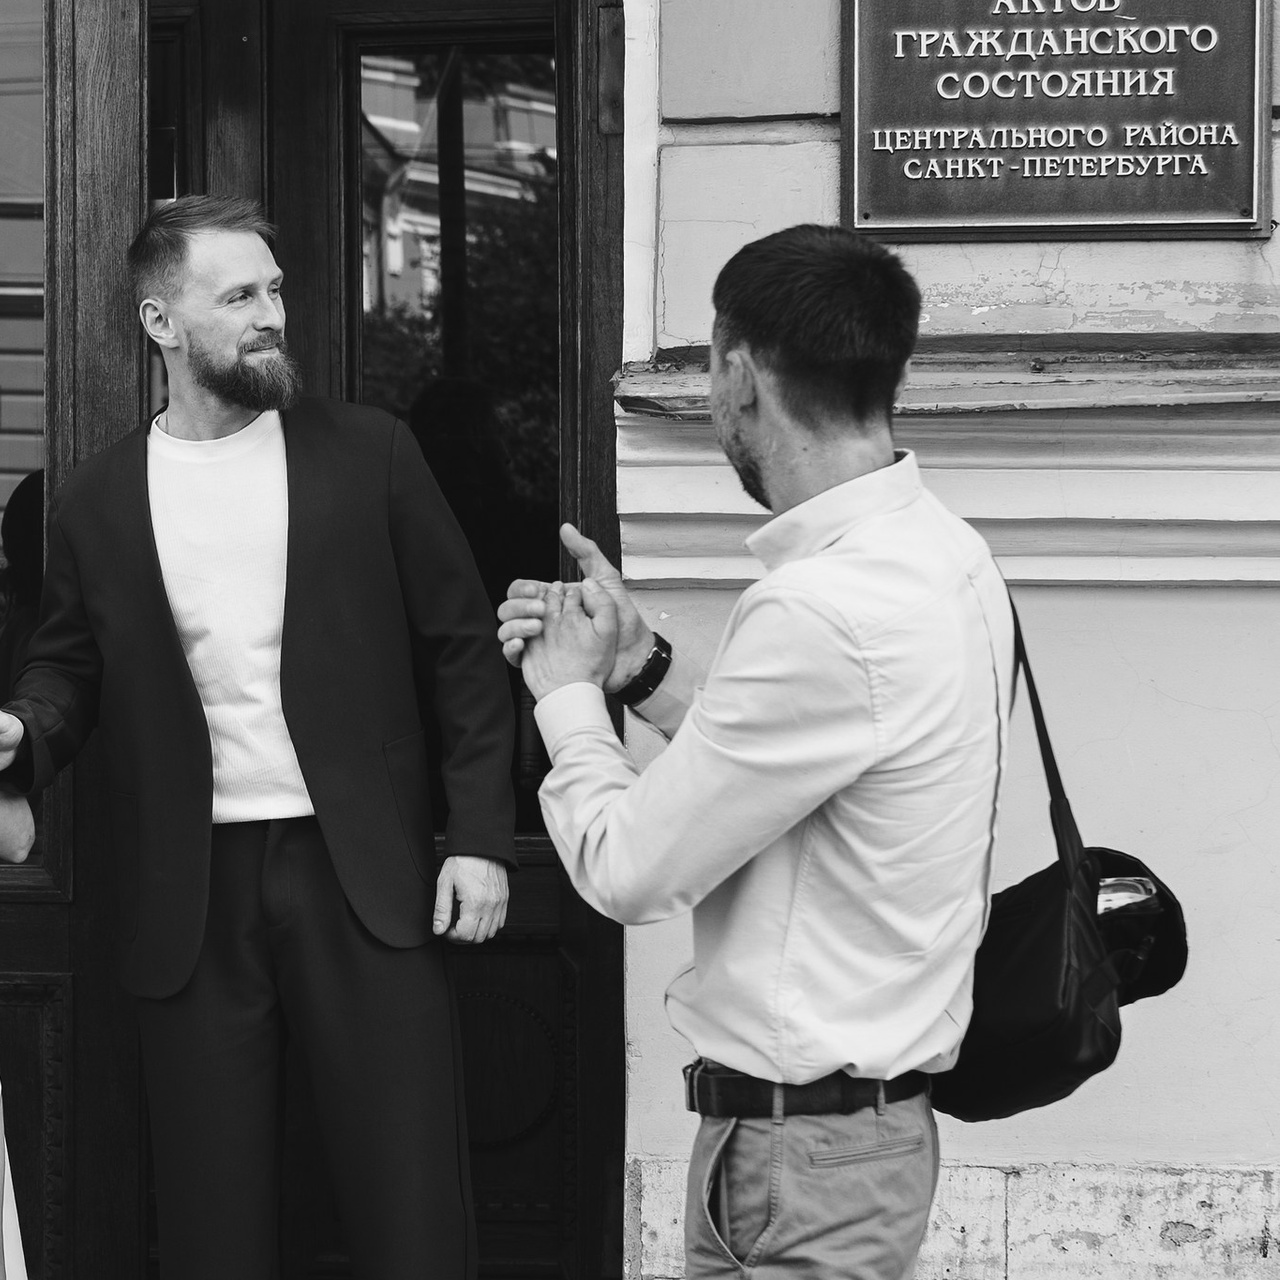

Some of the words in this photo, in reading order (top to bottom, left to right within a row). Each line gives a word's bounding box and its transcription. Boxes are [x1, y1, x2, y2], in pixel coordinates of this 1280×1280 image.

[894, 24, 1218, 61] ГРАЖДАНСКОГО
[936, 67, 1175, 99] СОСТОЯНИЯ
[873, 125, 1108, 154] ЦЕНТРАЛЬНОГО
[1122, 120, 1240, 146] РАЙОНА
[903, 153, 1209, 179] САНКТ-ПЕТЕРБУРГА
